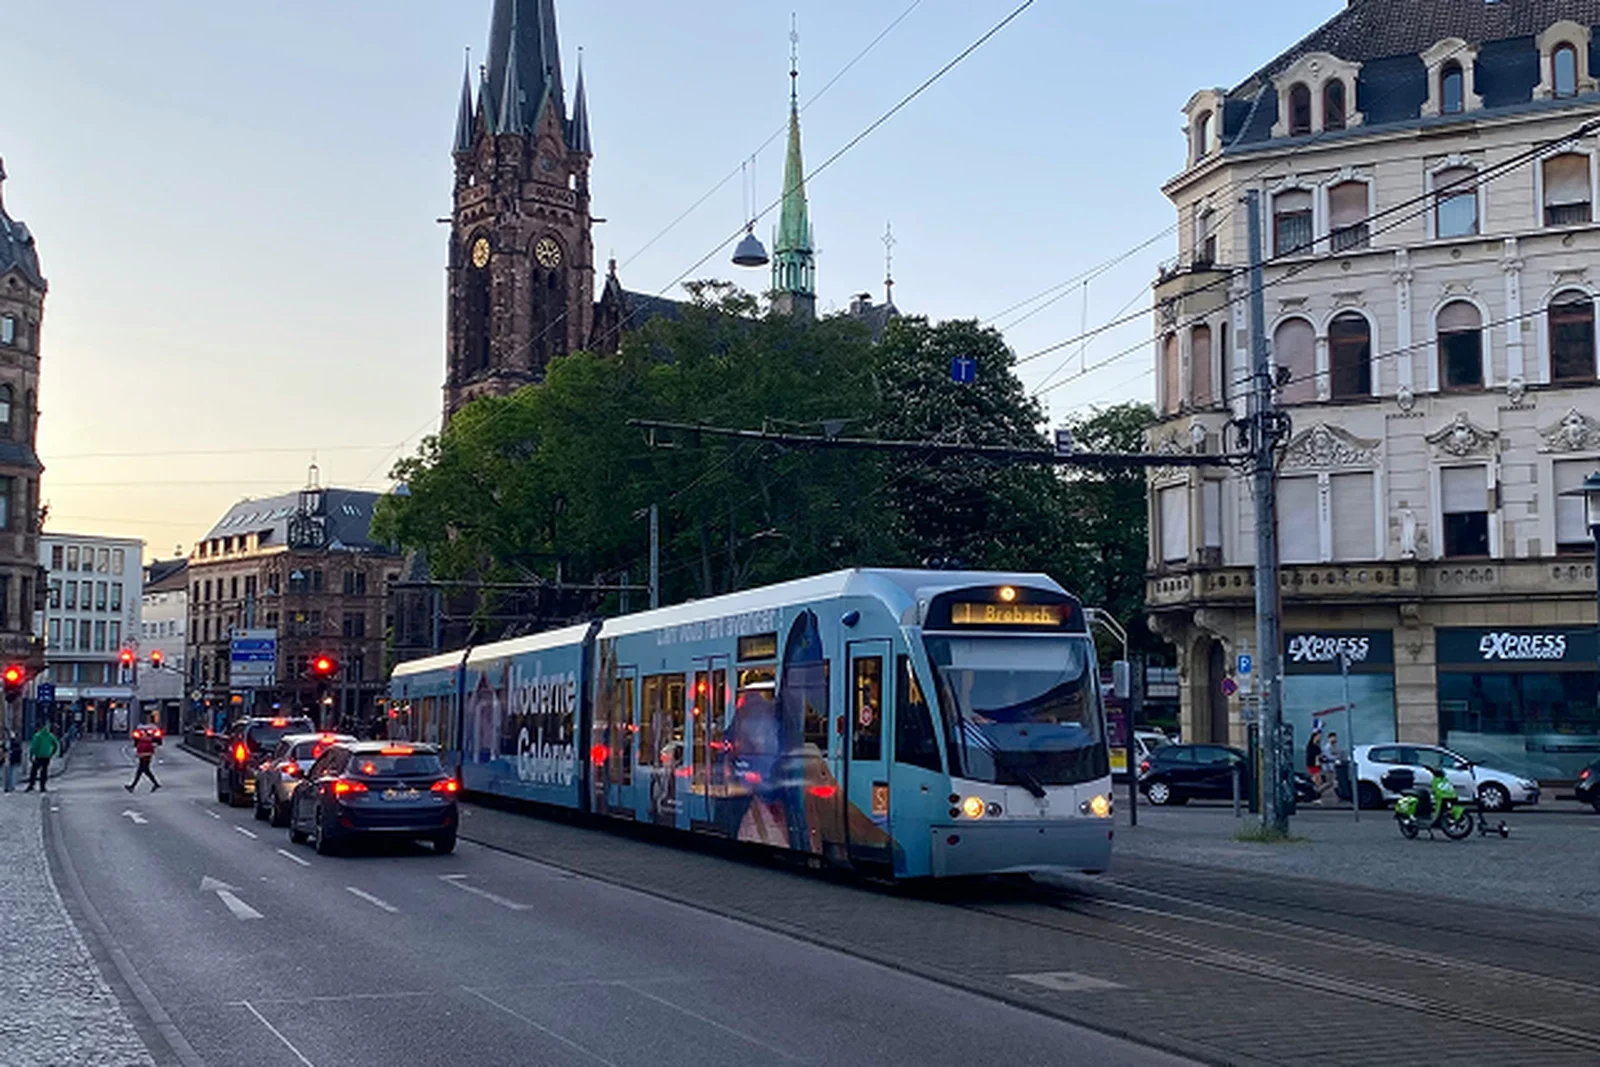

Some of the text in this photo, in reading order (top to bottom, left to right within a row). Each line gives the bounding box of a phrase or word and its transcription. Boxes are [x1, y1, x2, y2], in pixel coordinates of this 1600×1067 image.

[957, 359, 971, 380] T
[508, 659, 576, 717] Moderne
[517, 726, 575, 786] Galerie
